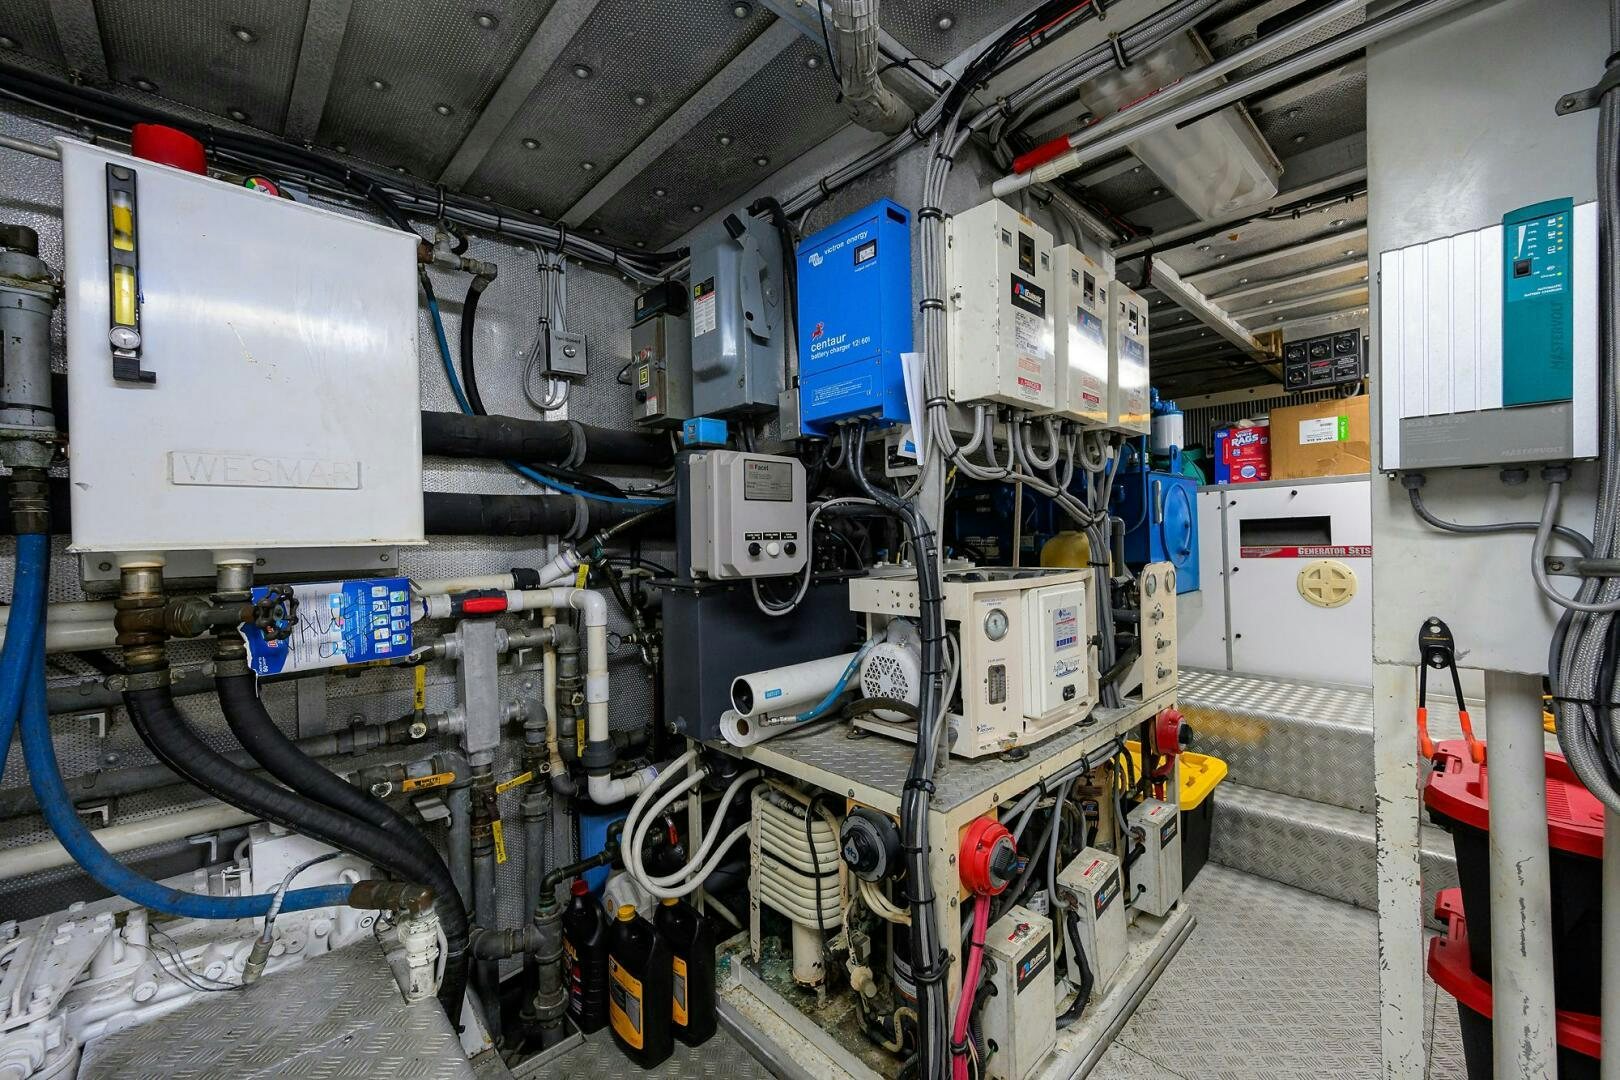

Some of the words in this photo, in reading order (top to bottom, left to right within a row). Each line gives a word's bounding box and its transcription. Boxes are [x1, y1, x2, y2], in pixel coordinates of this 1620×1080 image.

[824, 241, 844, 255] victron
[846, 230, 868, 245] energy
[810, 333, 847, 352] centaur
[810, 350, 830, 360] battery
[829, 343, 851, 353] charger
[1231, 434, 1259, 447] RAGS
[182, 454, 349, 485] WESMAR
[754, 463, 769, 471] Facet
[1298, 546, 1346, 555] GENERATOR
[1348, 546, 1371, 555] SETS
